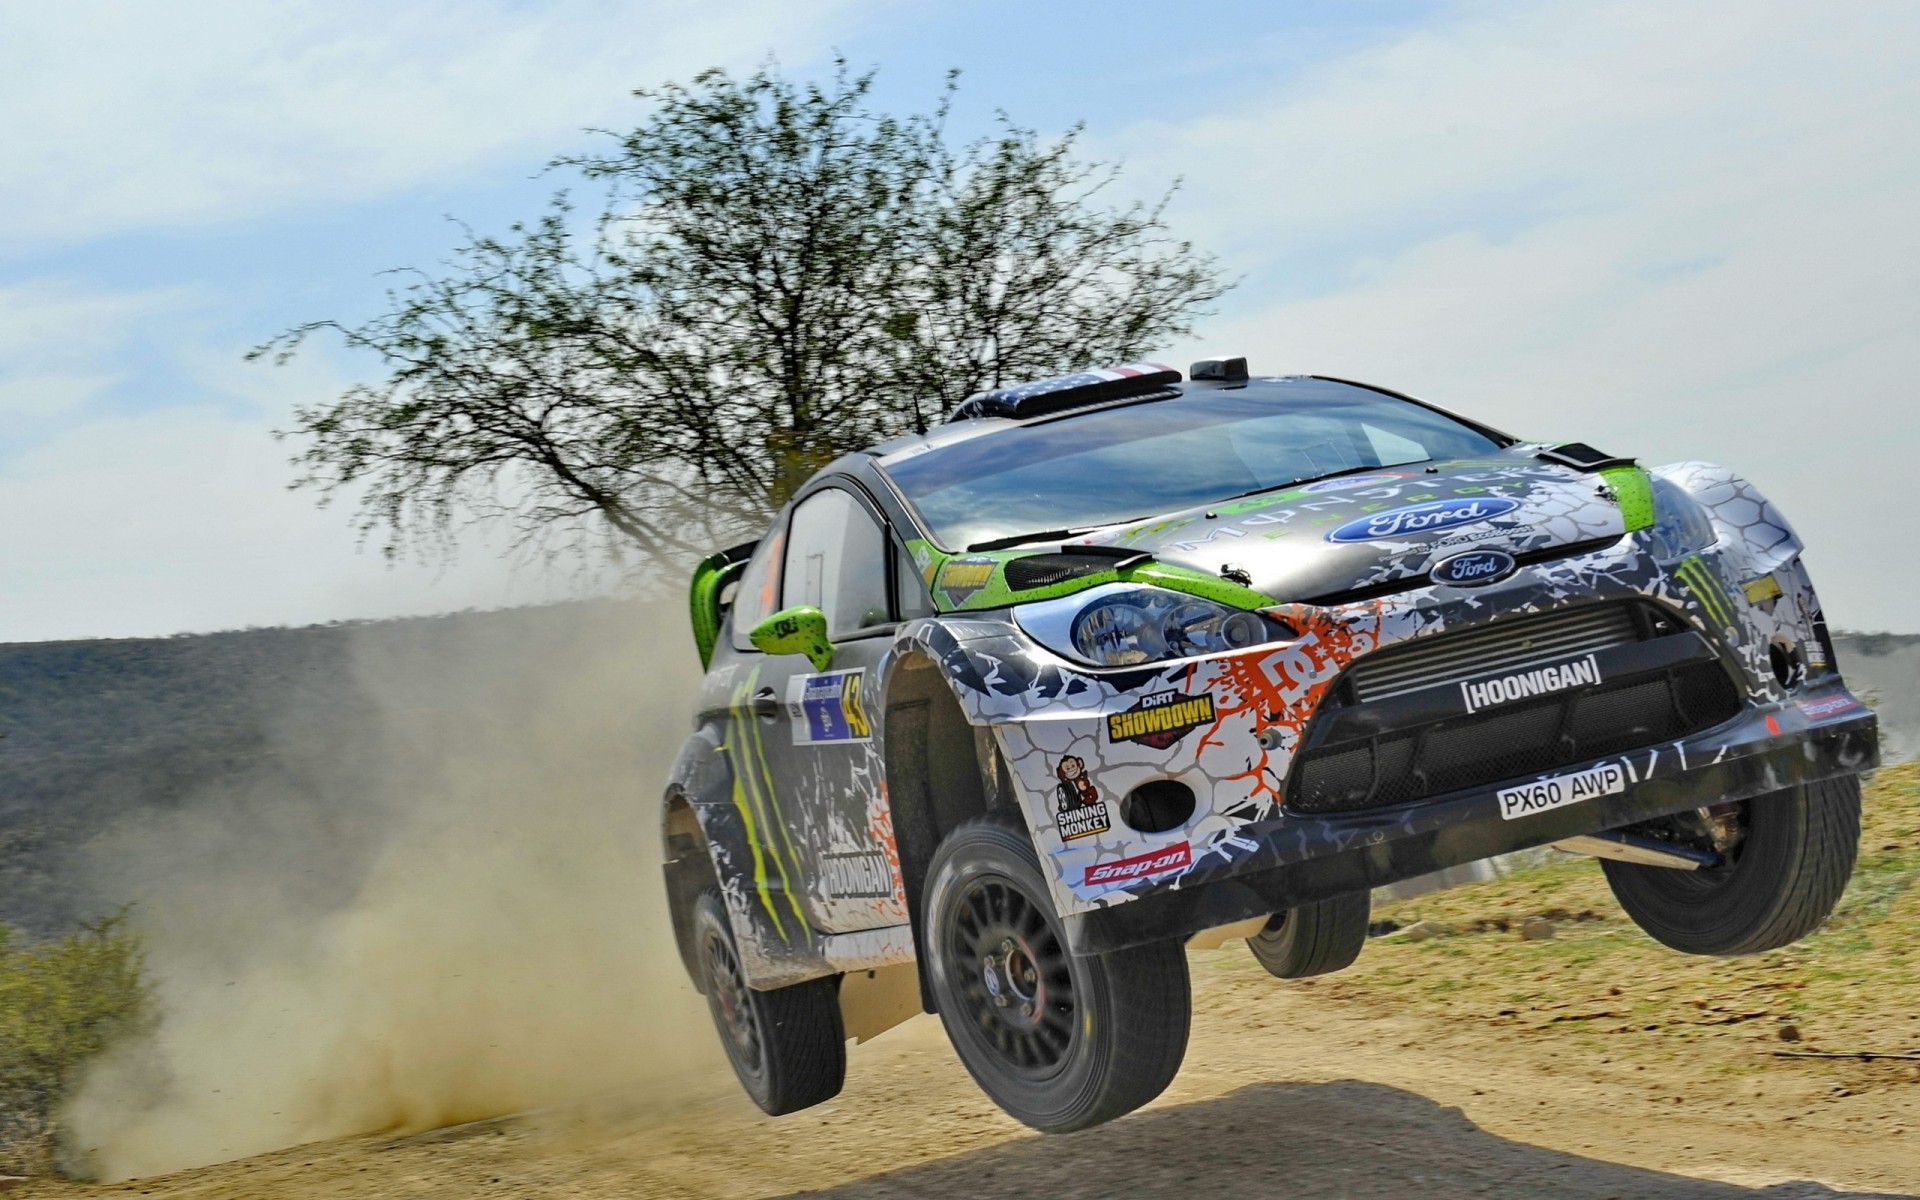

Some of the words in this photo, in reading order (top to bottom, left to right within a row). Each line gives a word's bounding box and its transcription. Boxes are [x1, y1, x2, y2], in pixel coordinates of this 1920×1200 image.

[1262, 481, 1524, 540] ENERGY
[1368, 502, 1489, 537] Ford
[1432, 537, 1468, 550] FORD
[1469, 525, 1535, 543] EcoBoost
[1452, 556, 1498, 579] Ford
[1257, 630, 1341, 707] DC
[1142, 691, 1177, 708] DiRT
[1110, 697, 1214, 740] SHOWDOWN
[1503, 782, 1562, 815] PX60
[1571, 769, 1619, 799] AWP
[1057, 803, 1106, 826] SHINING
[1060, 816, 1109, 838] MONKEY
[1088, 849, 1186, 882] Snap-on
